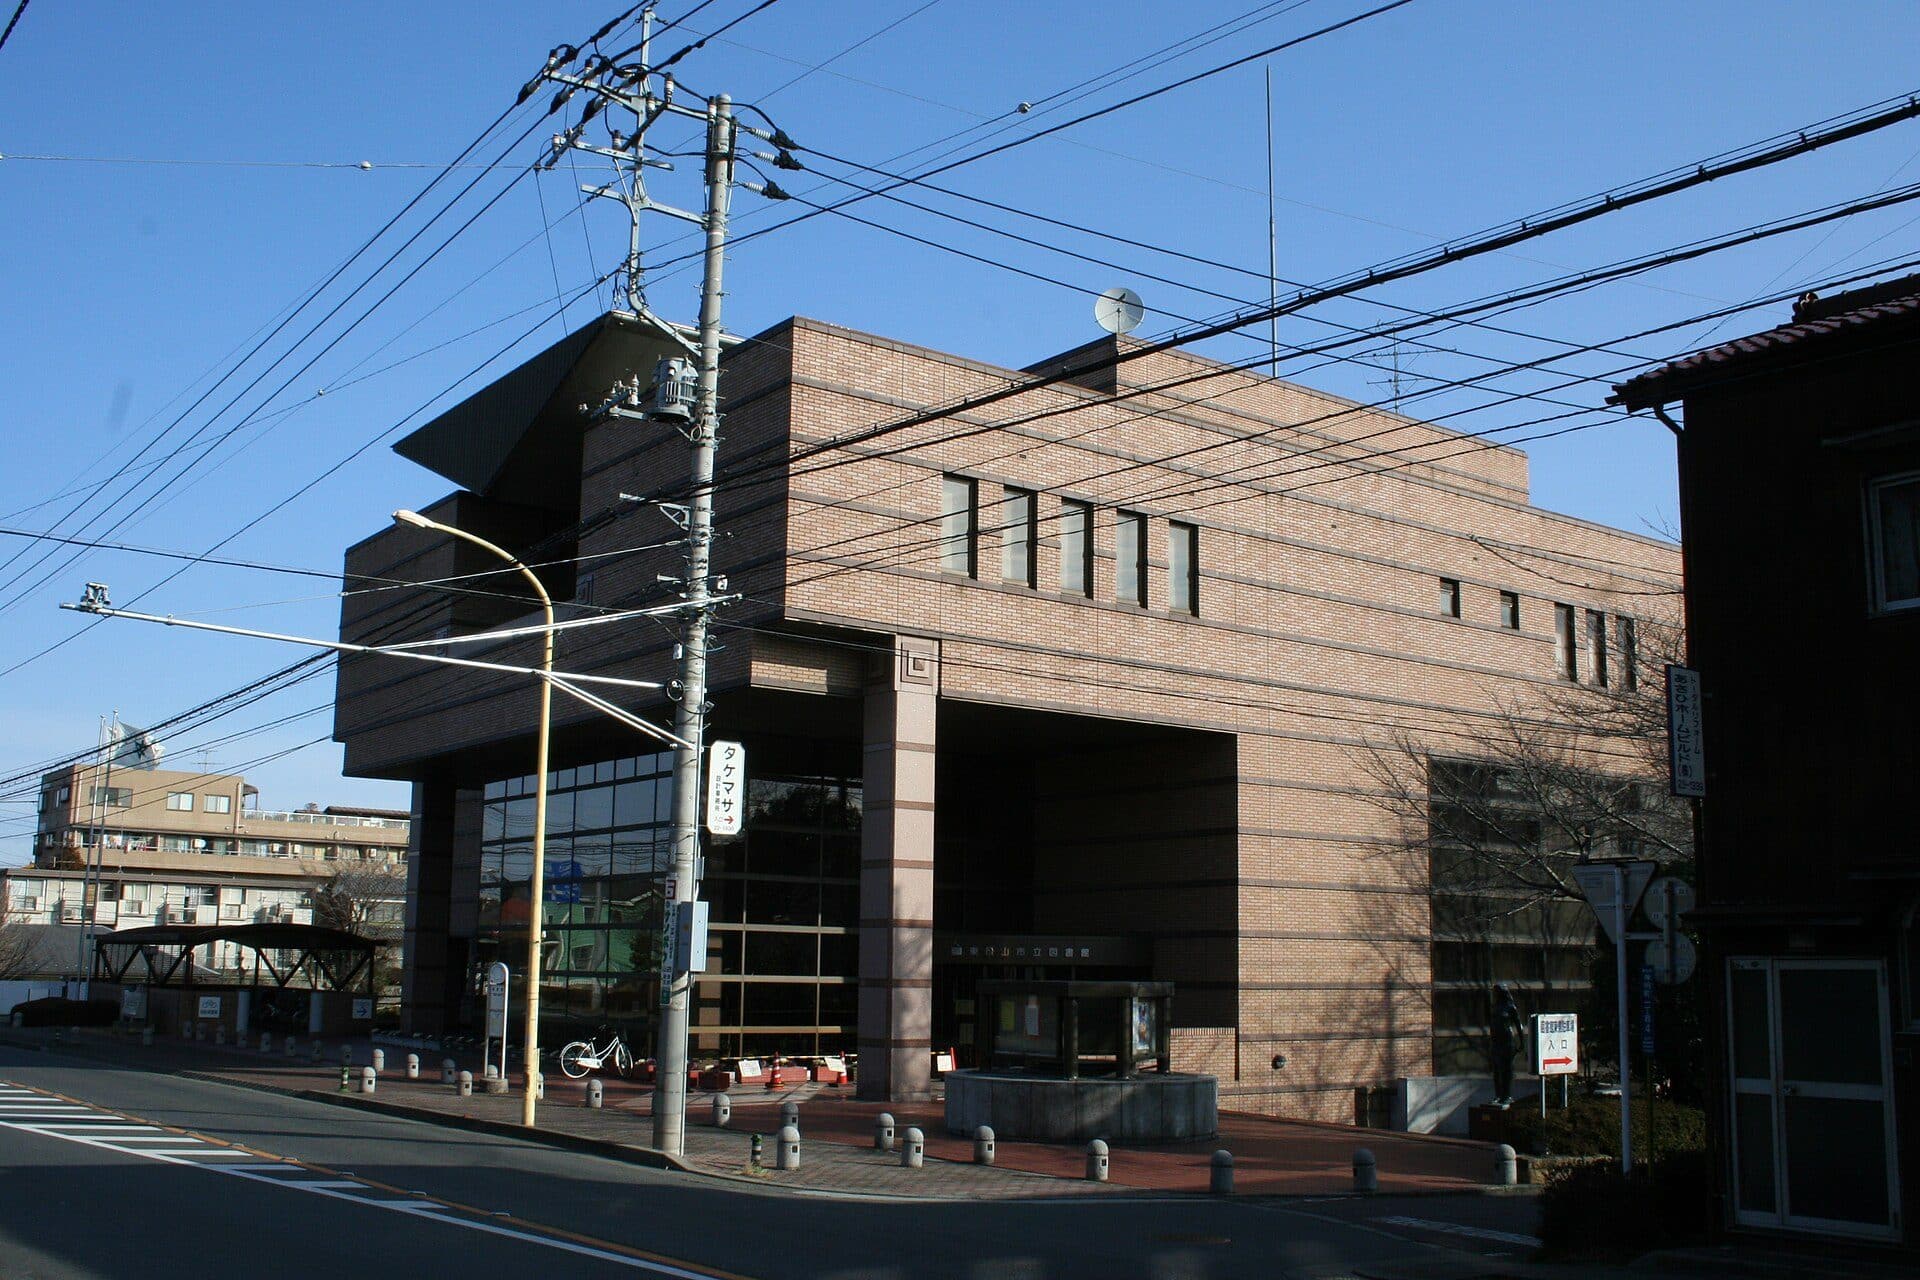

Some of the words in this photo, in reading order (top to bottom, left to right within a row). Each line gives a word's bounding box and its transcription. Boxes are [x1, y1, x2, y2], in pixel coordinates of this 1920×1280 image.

[722, 746, 736, 813] タケマサ
[1548, 1039, 1568, 1051] 入口
